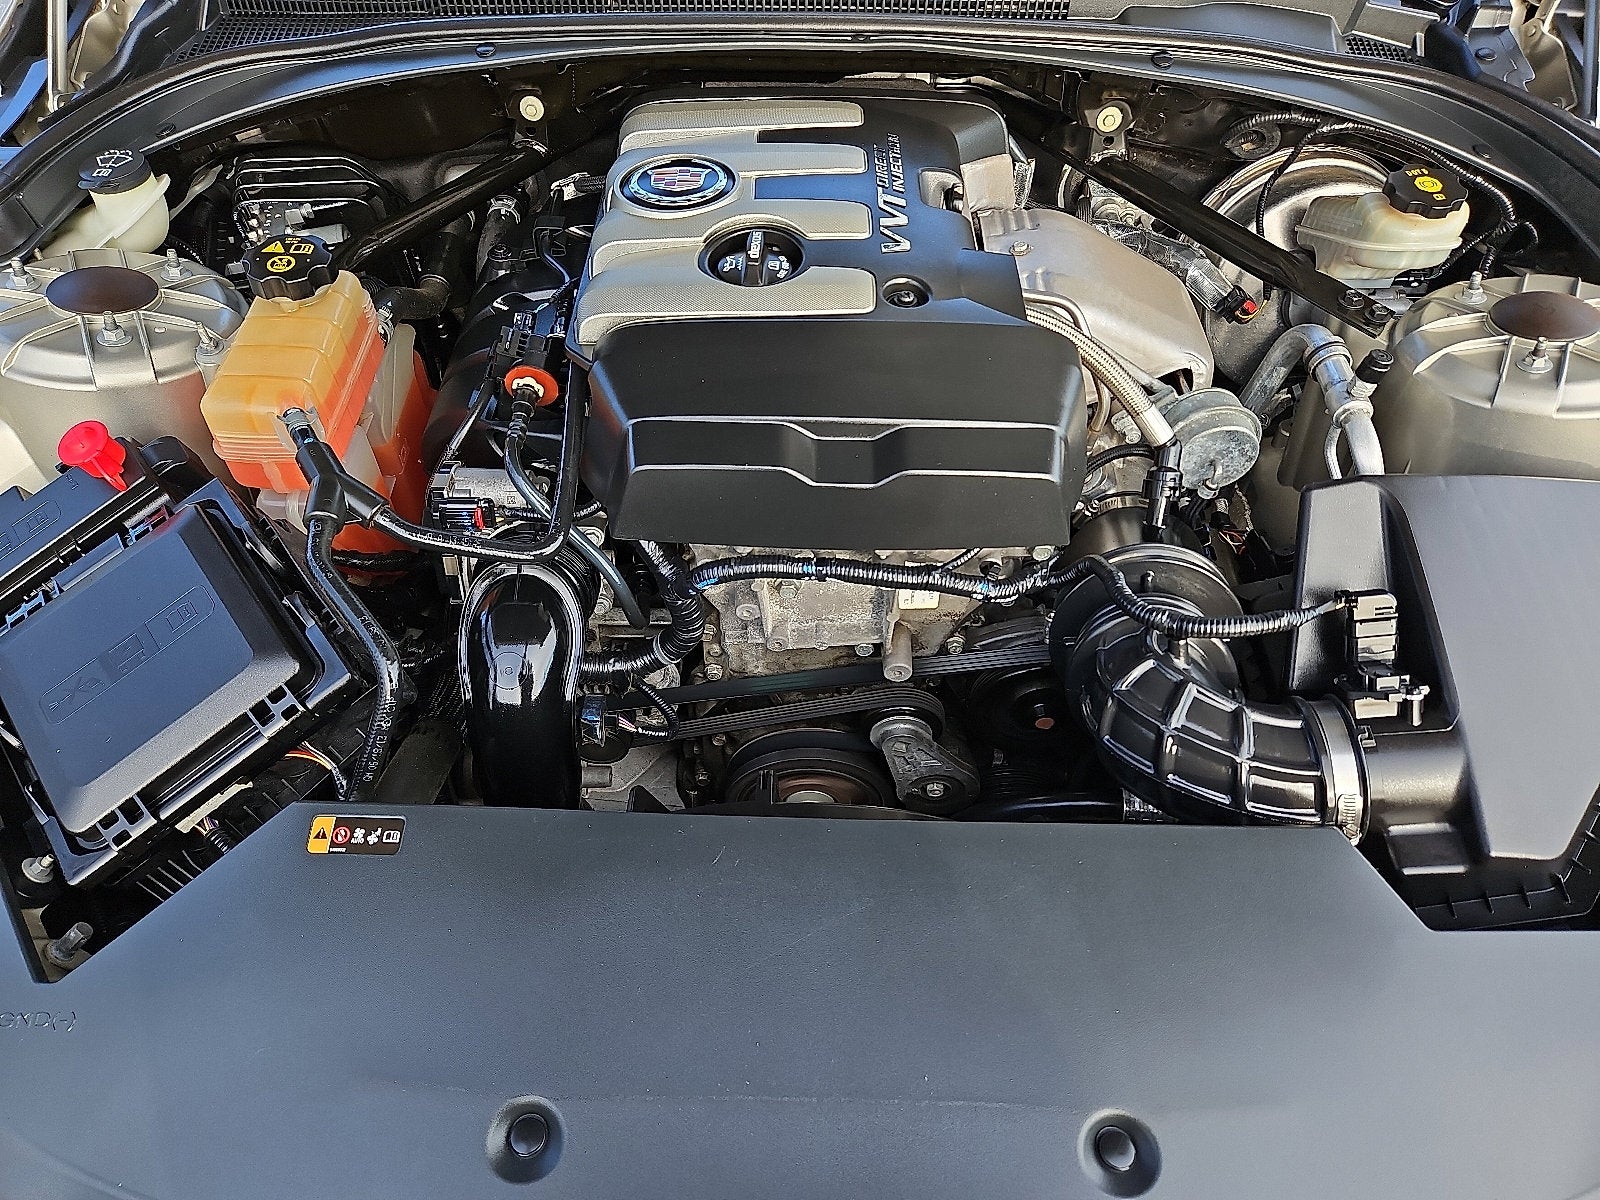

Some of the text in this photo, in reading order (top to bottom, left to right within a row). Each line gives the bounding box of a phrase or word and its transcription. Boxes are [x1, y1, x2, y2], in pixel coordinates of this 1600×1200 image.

[873, 144, 889, 188] DIRECT
[887, 132, 906, 193] INJECTION
[1405, 168, 1422, 177] DOT
[876, 186, 912, 254] VVT
[747, 231, 762, 259] dexos
[0, 1010, 77, 1033] GND(-)
